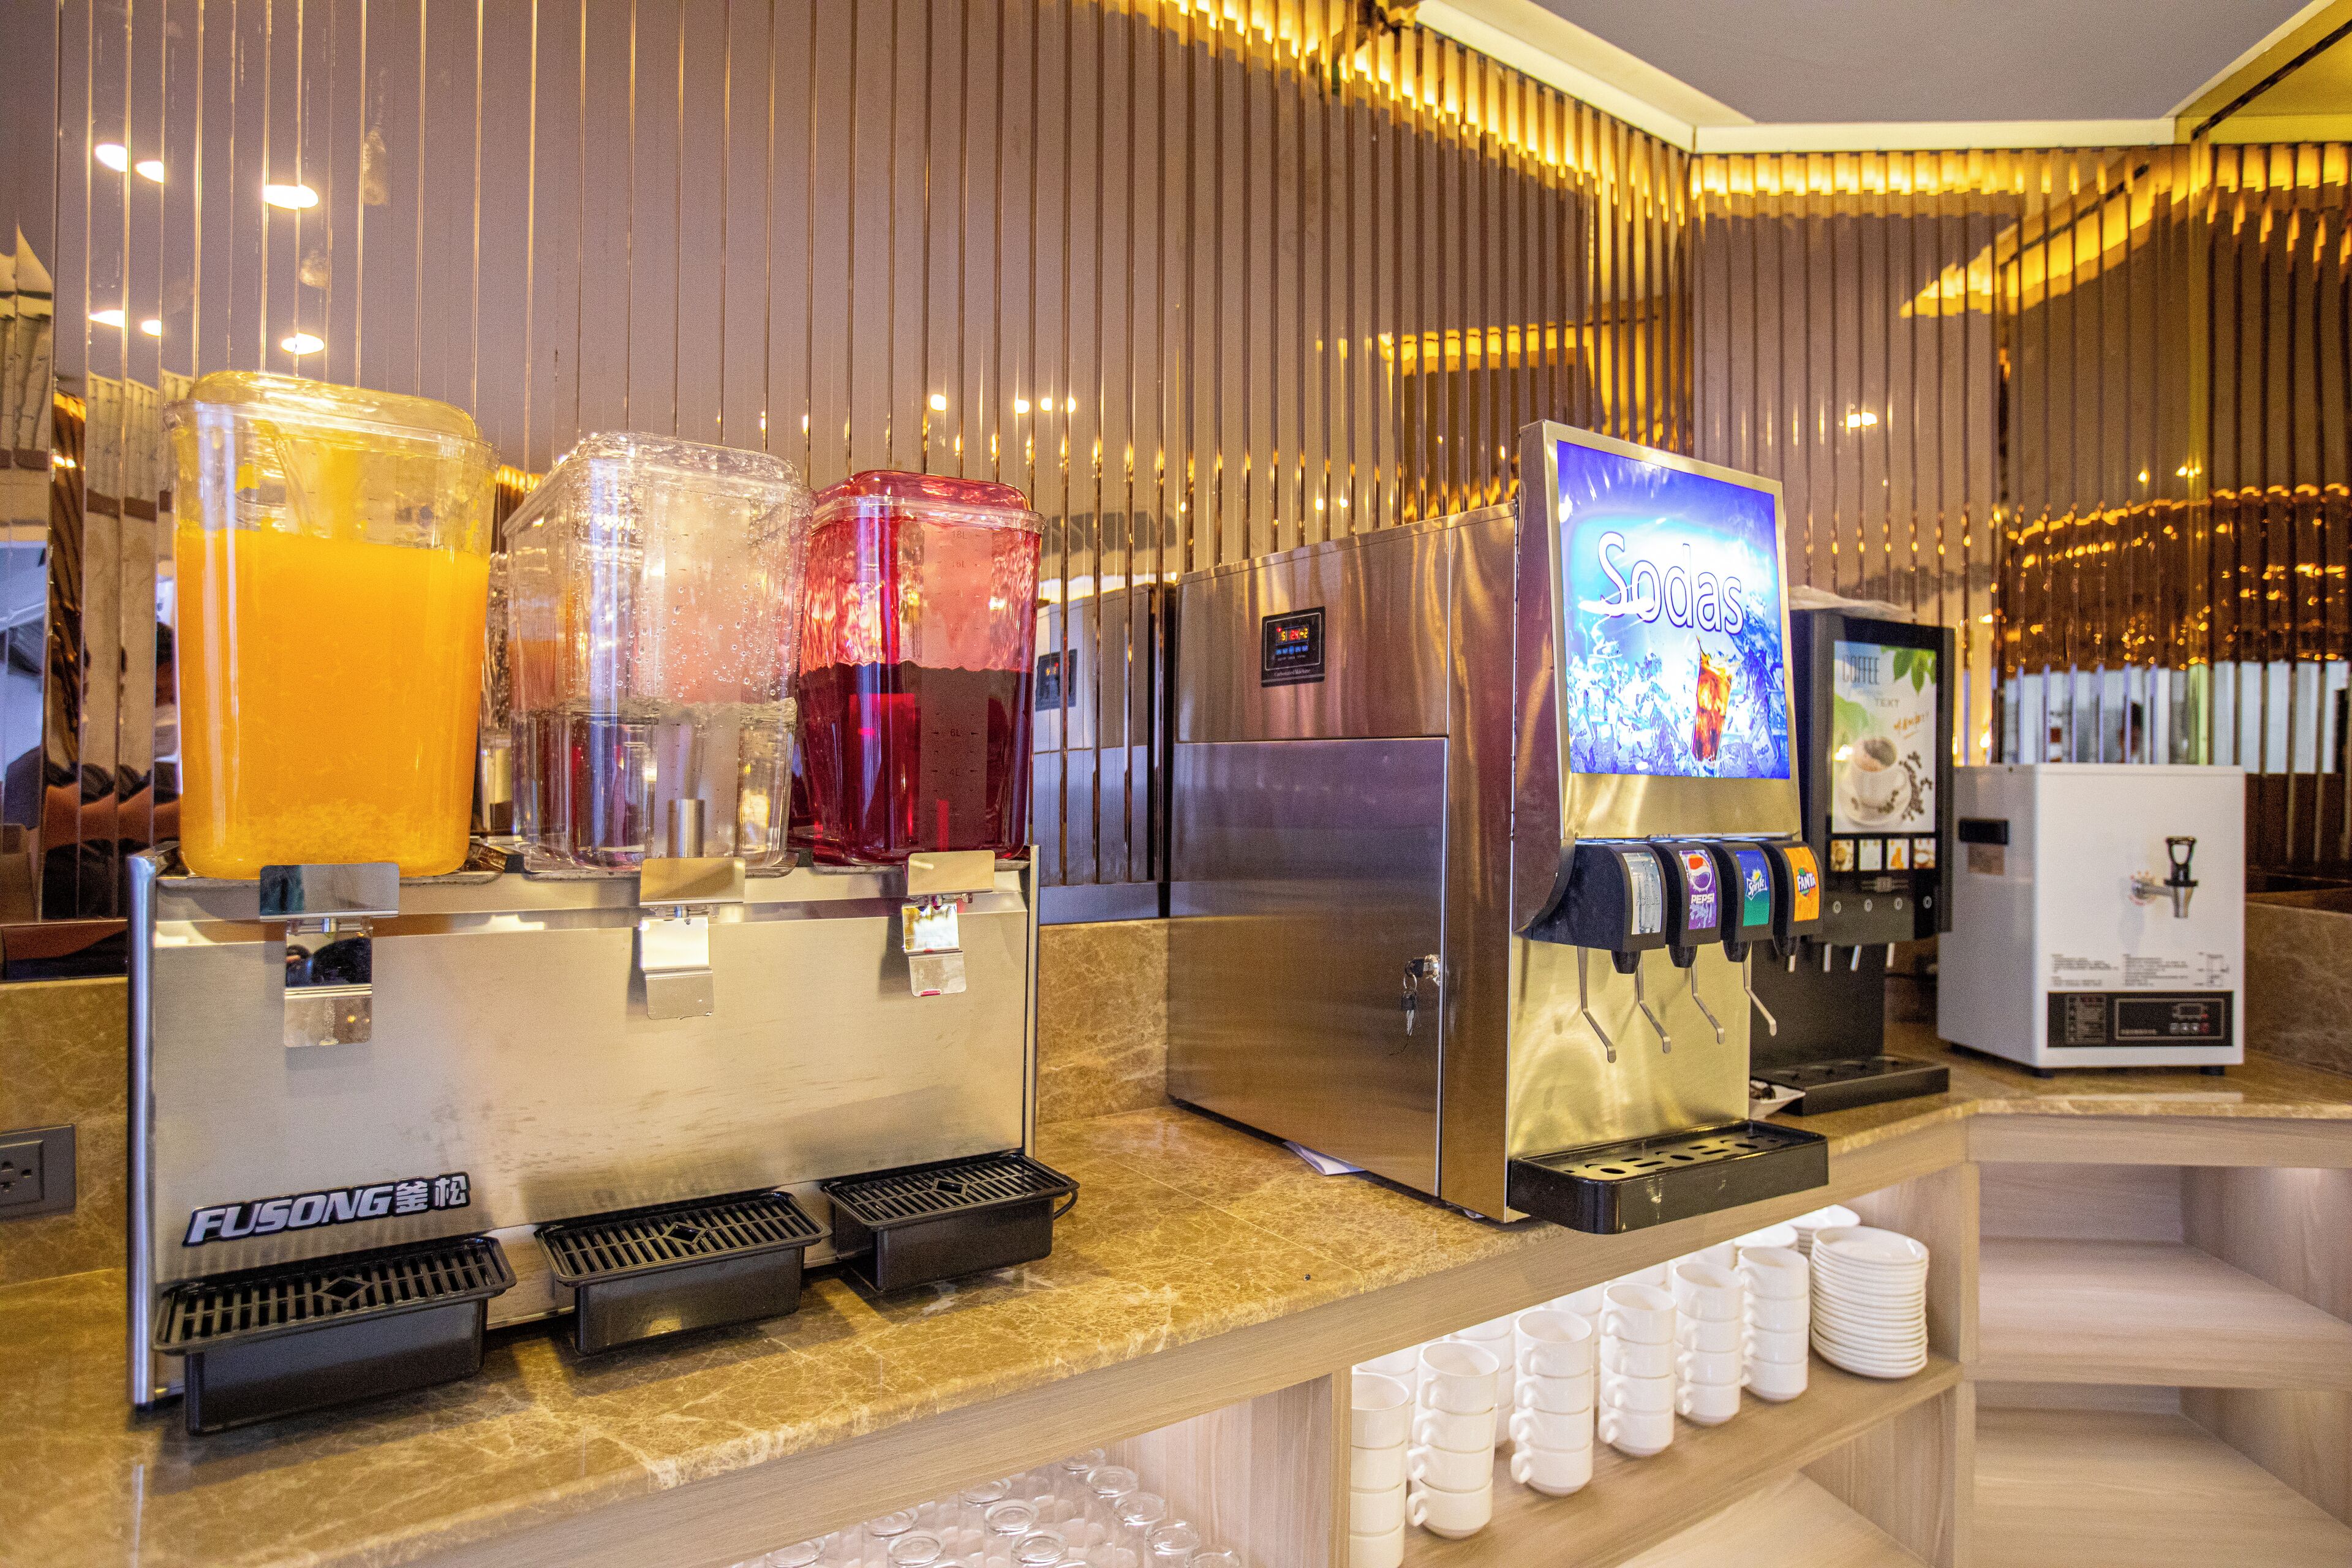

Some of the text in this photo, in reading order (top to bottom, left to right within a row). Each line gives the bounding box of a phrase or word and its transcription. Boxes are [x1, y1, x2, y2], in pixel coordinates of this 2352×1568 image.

[952, 530, 967, 540] 18L
[1598, 531, 1744, 635] Sodas
[1842, 655, 1880, 685] COFFEE
[1747, 878, 1765, 896] Sprite
[1797, 872, 1817, 892] FANTA
[1636, 895, 1660, 908] Acqua
[1691, 892, 1714, 904] PEPSI
[187, 1175, 467, 1244] FUSONG 釜松
